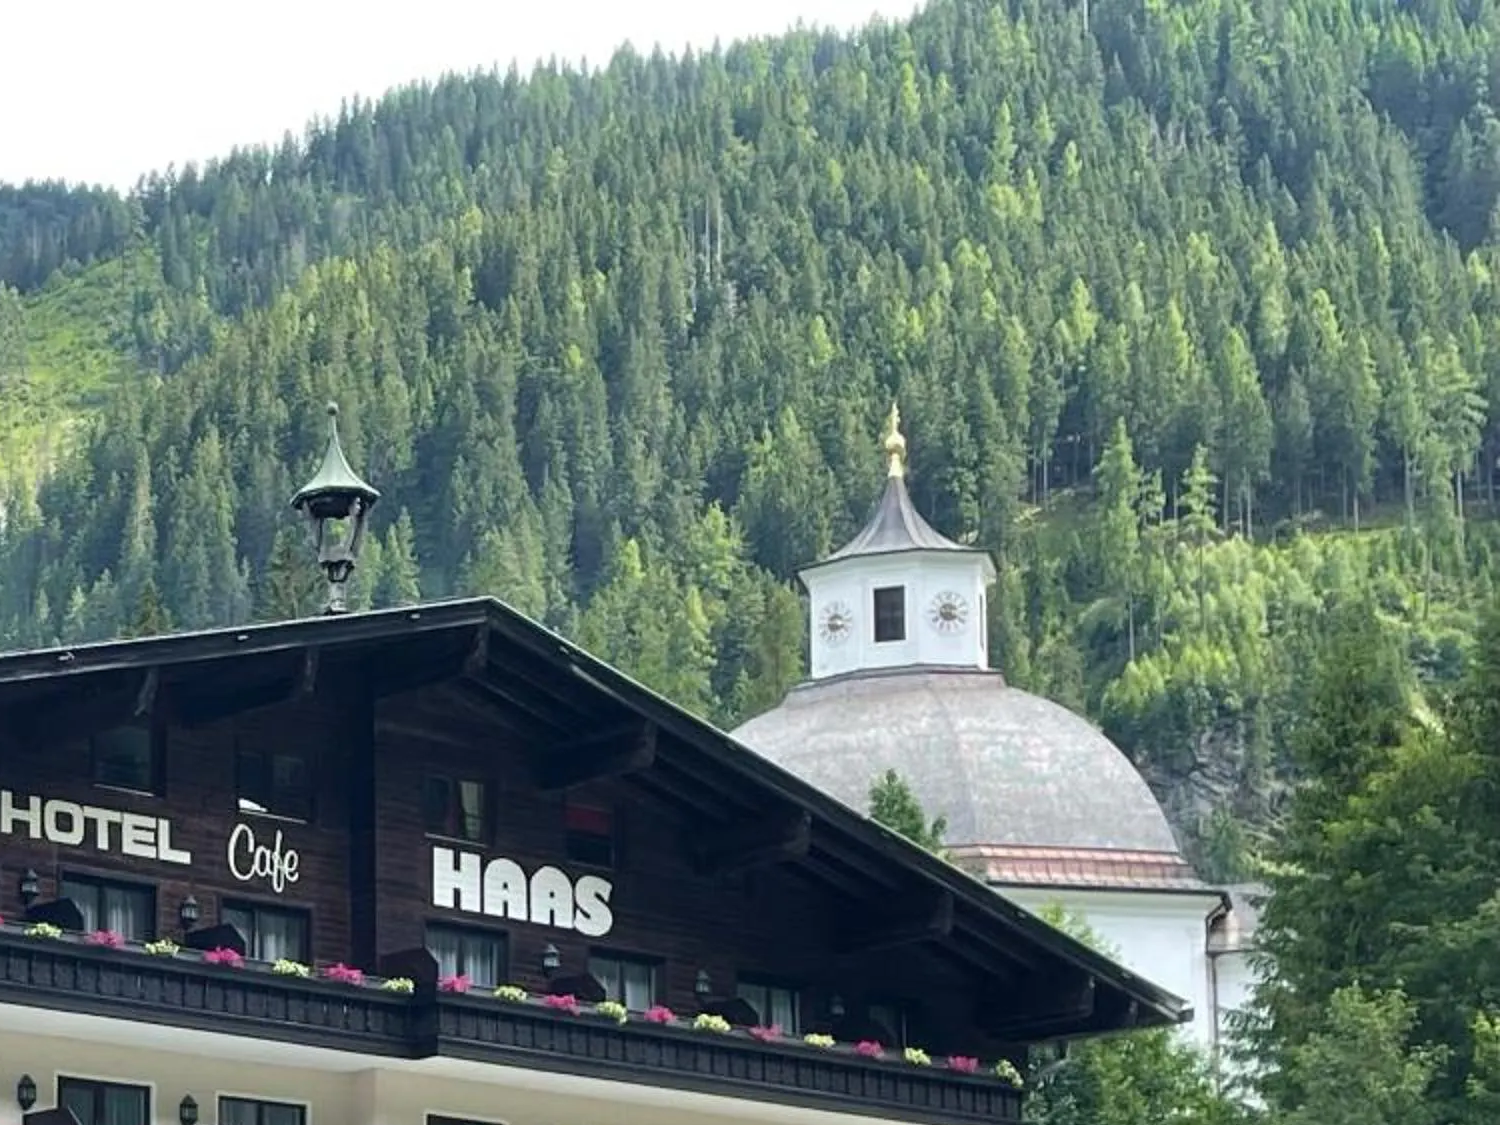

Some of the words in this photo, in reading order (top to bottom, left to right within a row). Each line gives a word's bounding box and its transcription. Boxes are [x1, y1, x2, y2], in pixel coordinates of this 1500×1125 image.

[0, 790, 192, 865] HOTEL
[227, 823, 300, 894] Cafe
[432, 846, 614, 937] HAAS
